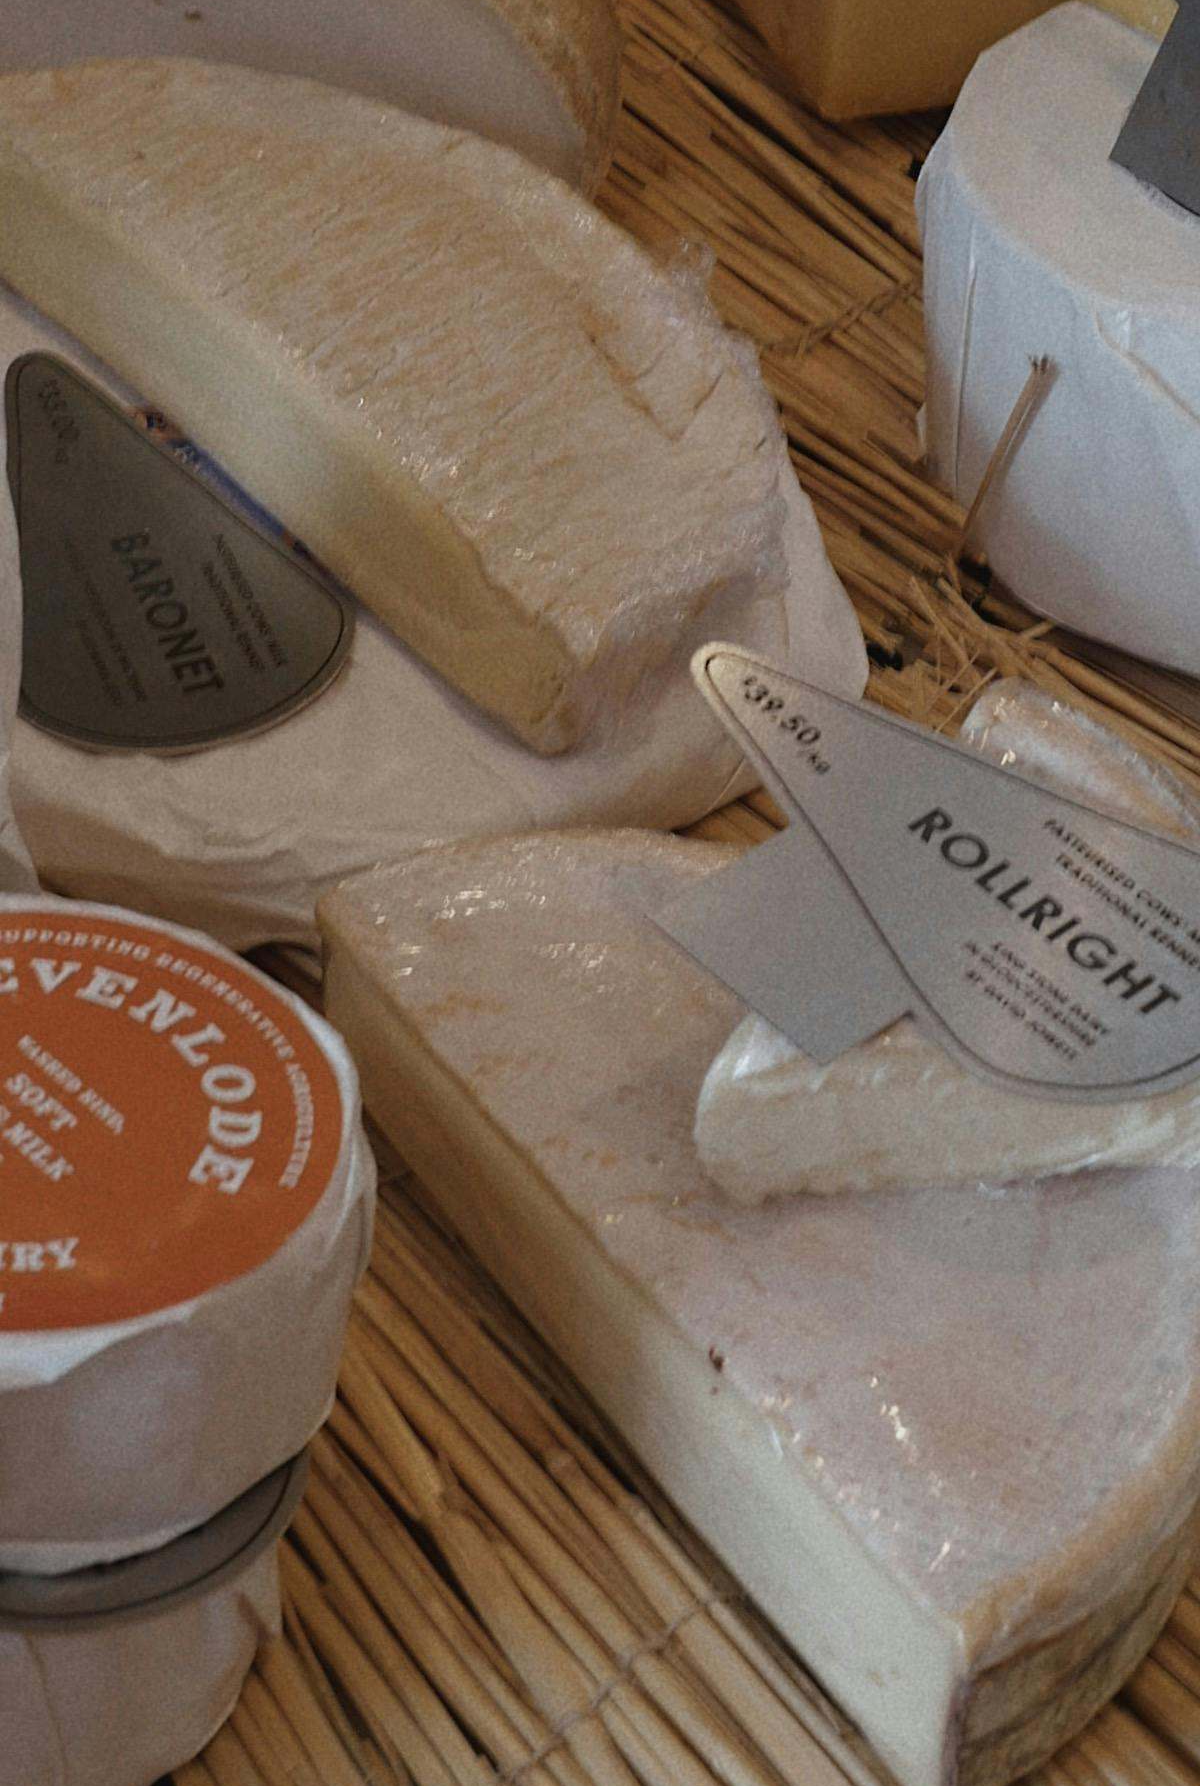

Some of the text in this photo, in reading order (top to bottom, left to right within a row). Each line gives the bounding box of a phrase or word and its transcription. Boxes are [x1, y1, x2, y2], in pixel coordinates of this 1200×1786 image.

[112, 531, 225, 697] BARONET
[907, 805, 1182, 1015] ROLLRIGHT
[1149, 928, 1200, 972] RENNE
[5, 1073, 78, 1131] SOFT
[2, 1121, 73, 1181] MILK
